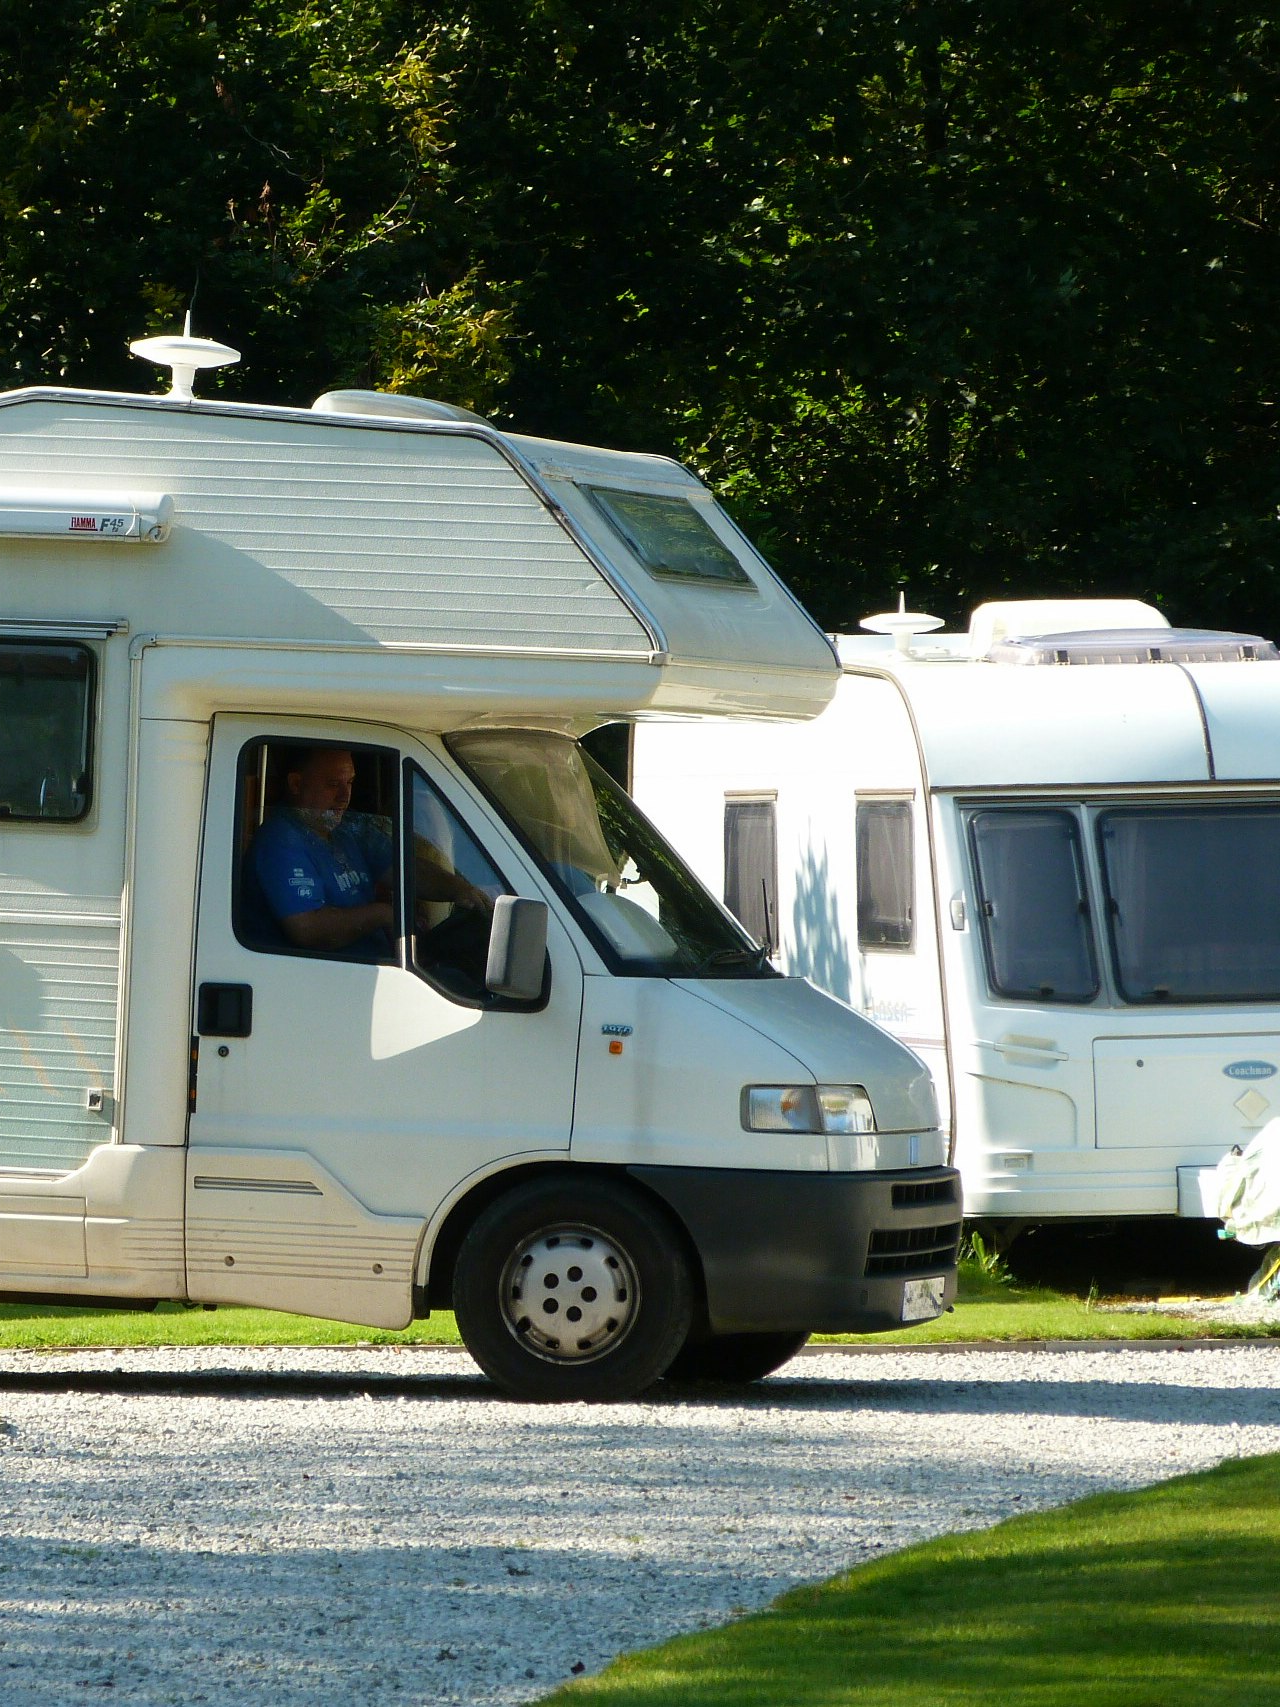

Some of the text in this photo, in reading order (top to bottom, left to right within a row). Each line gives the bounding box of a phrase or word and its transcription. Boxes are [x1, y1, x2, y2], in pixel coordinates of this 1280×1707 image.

[71, 516, 124, 531] FIAMMA F45
[1229, 1065, 1272, 1076] Coachman
